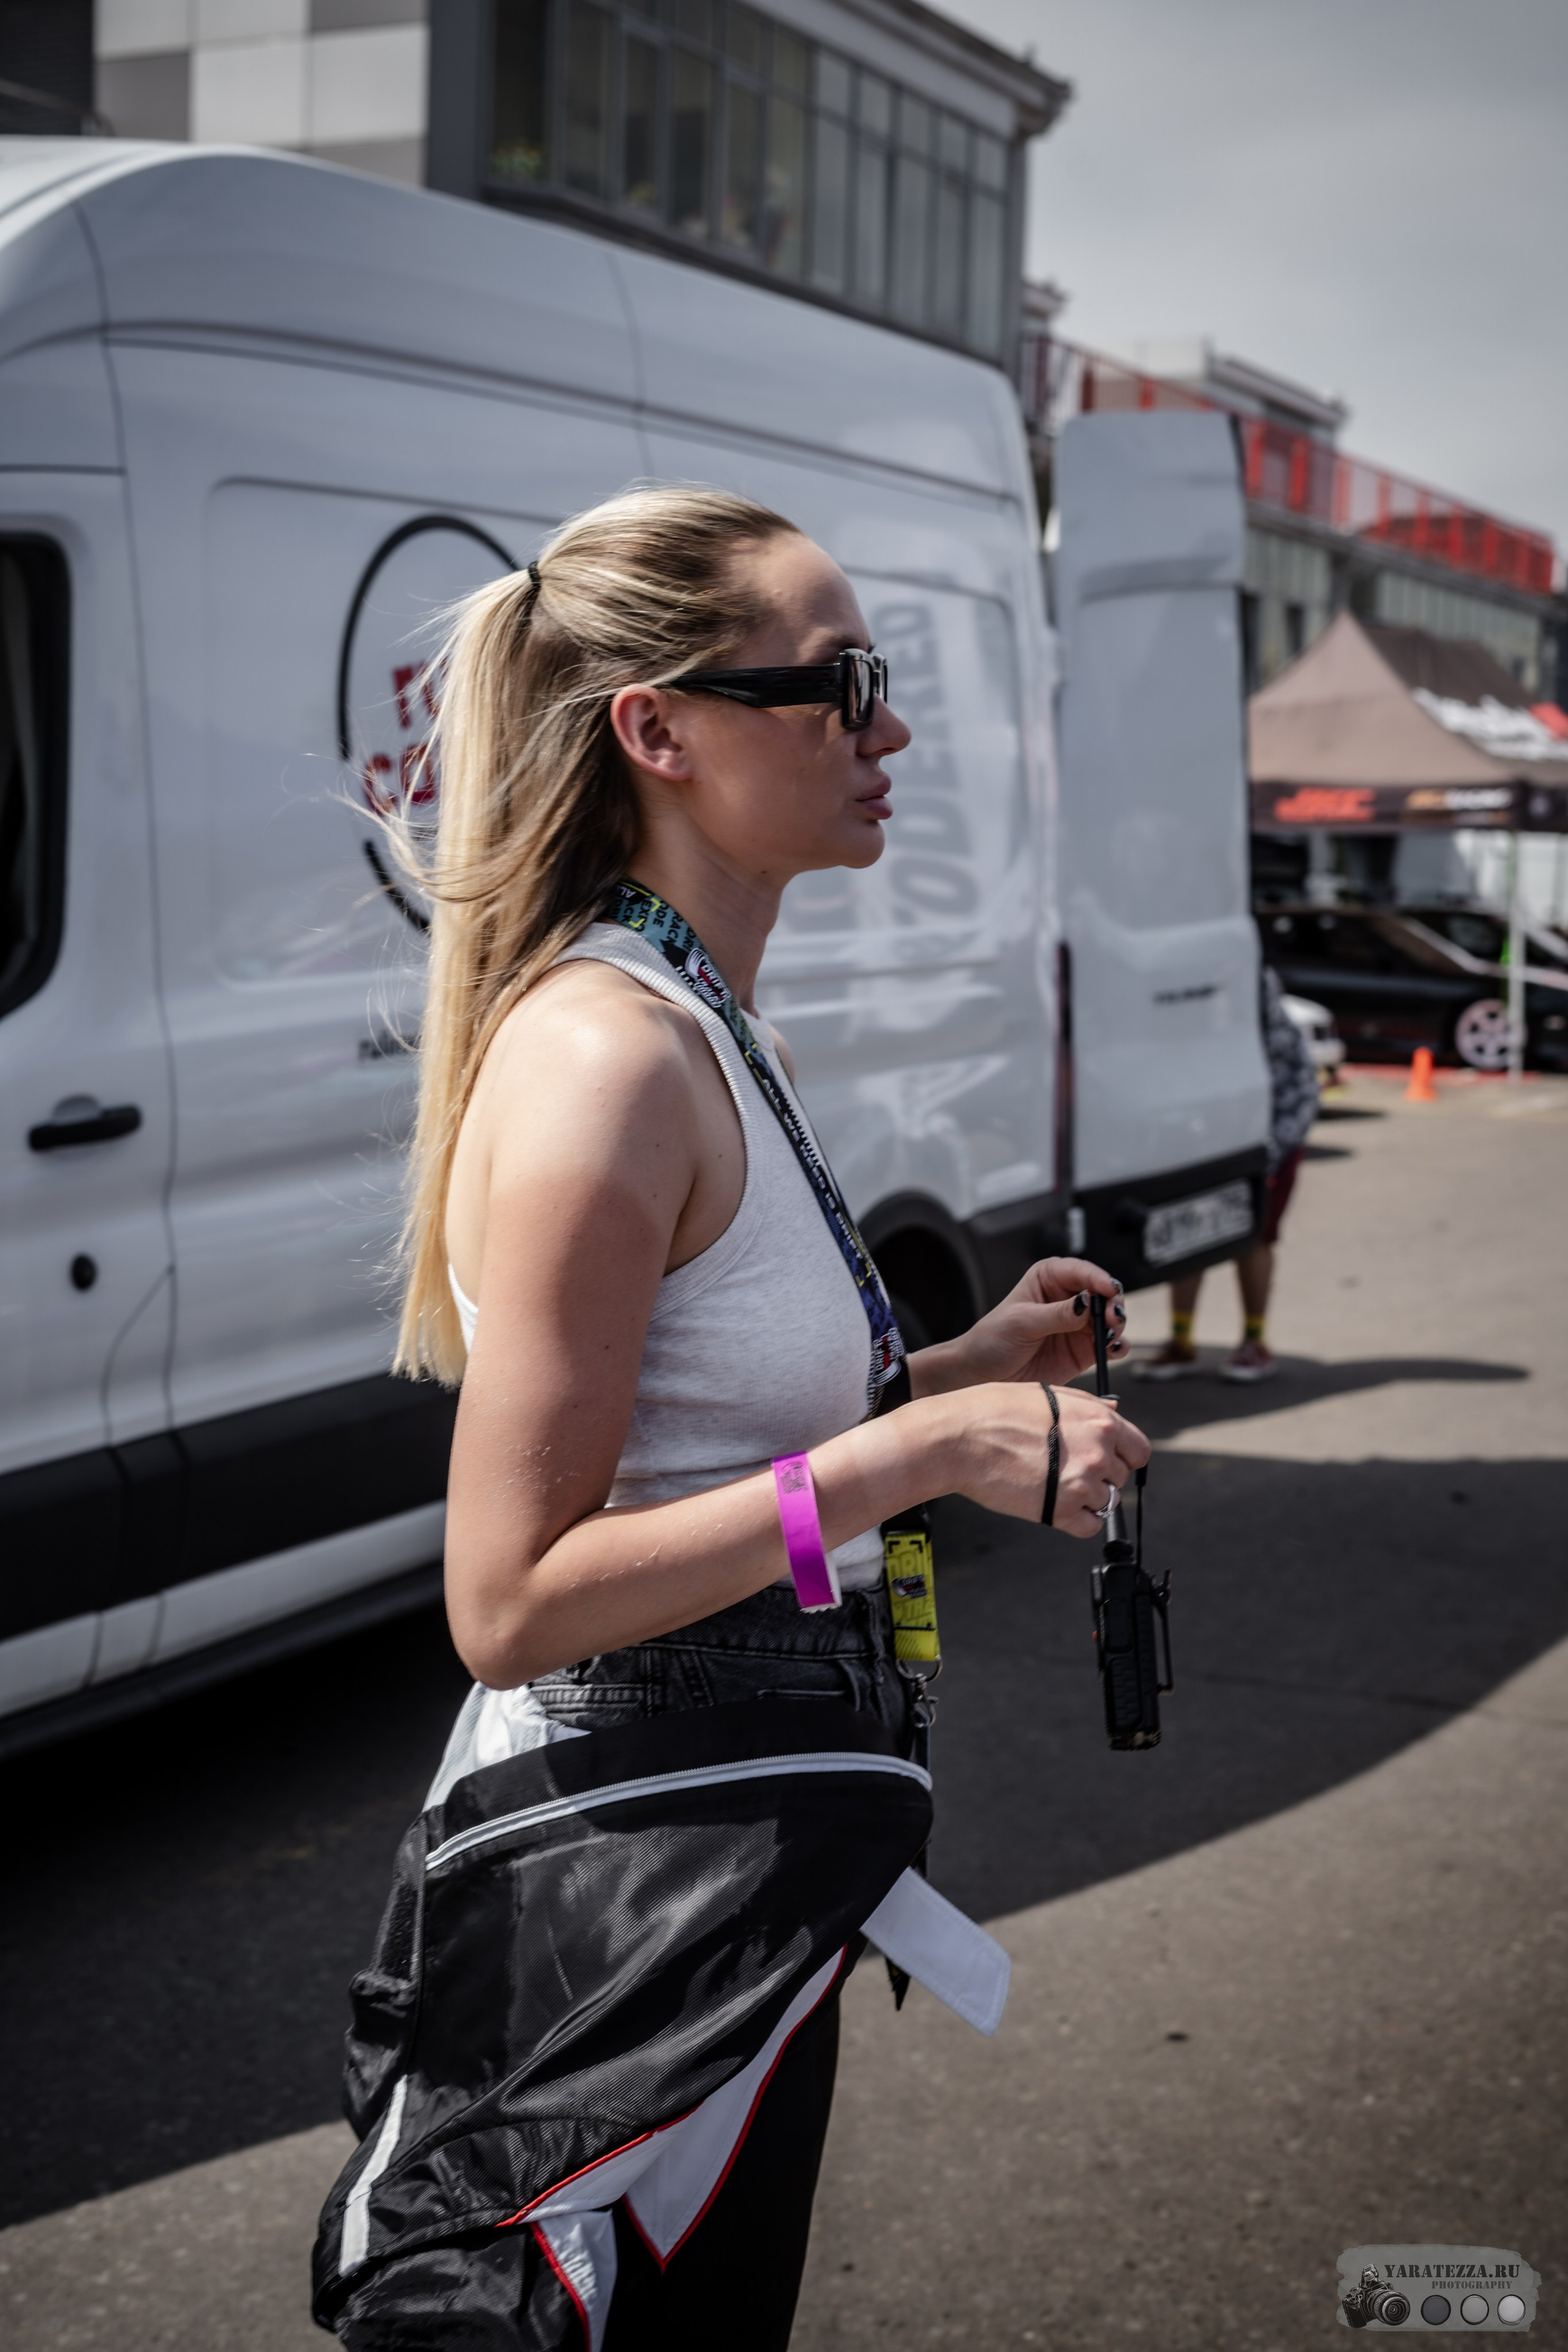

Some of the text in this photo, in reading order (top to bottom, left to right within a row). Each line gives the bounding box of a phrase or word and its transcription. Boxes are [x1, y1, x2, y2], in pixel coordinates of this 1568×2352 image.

[701, 963, 728, 998] DRIFT
[763, 1079, 863, 1260] ALL WE NEED IS DRIFT
